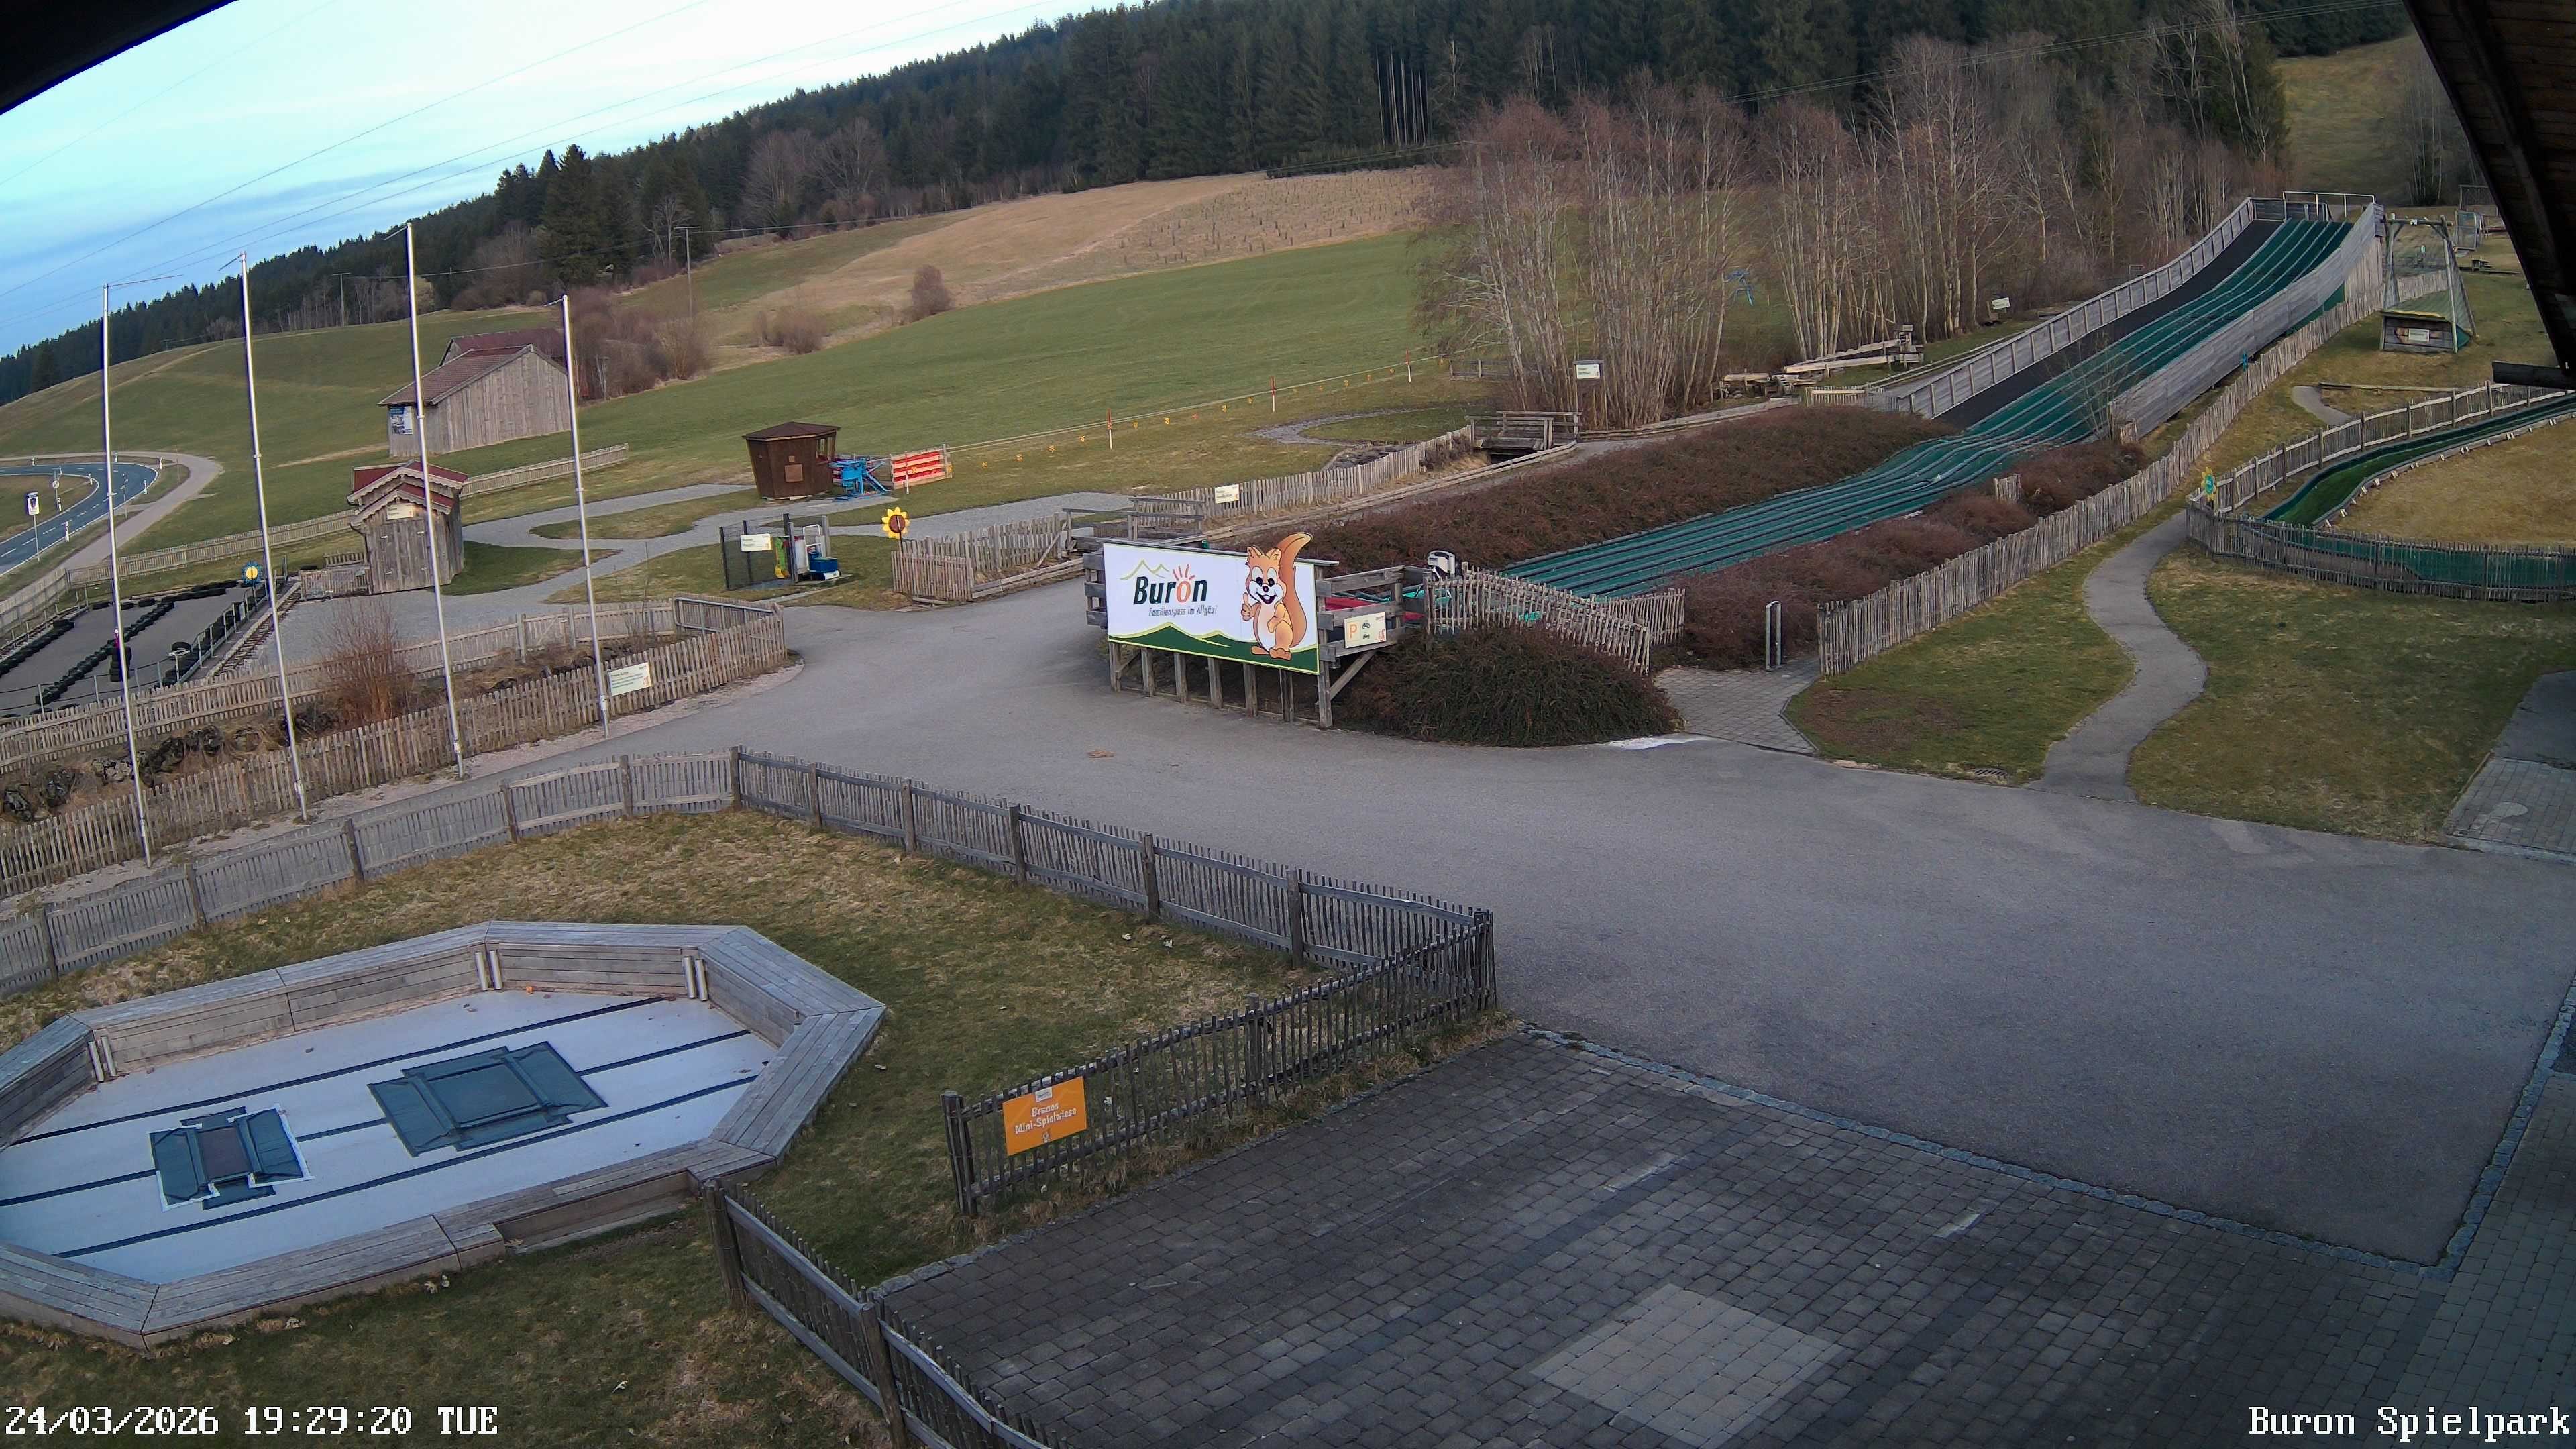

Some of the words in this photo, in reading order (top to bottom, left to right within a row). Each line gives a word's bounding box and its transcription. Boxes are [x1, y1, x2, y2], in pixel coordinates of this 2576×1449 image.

[1134, 576, 1208, 604] Buron
[1187, 606, 1195, 615] im
[1350, 623, 1358, 639] P
[1014, 1108, 1077, 1134] Mini-Spielwiese
